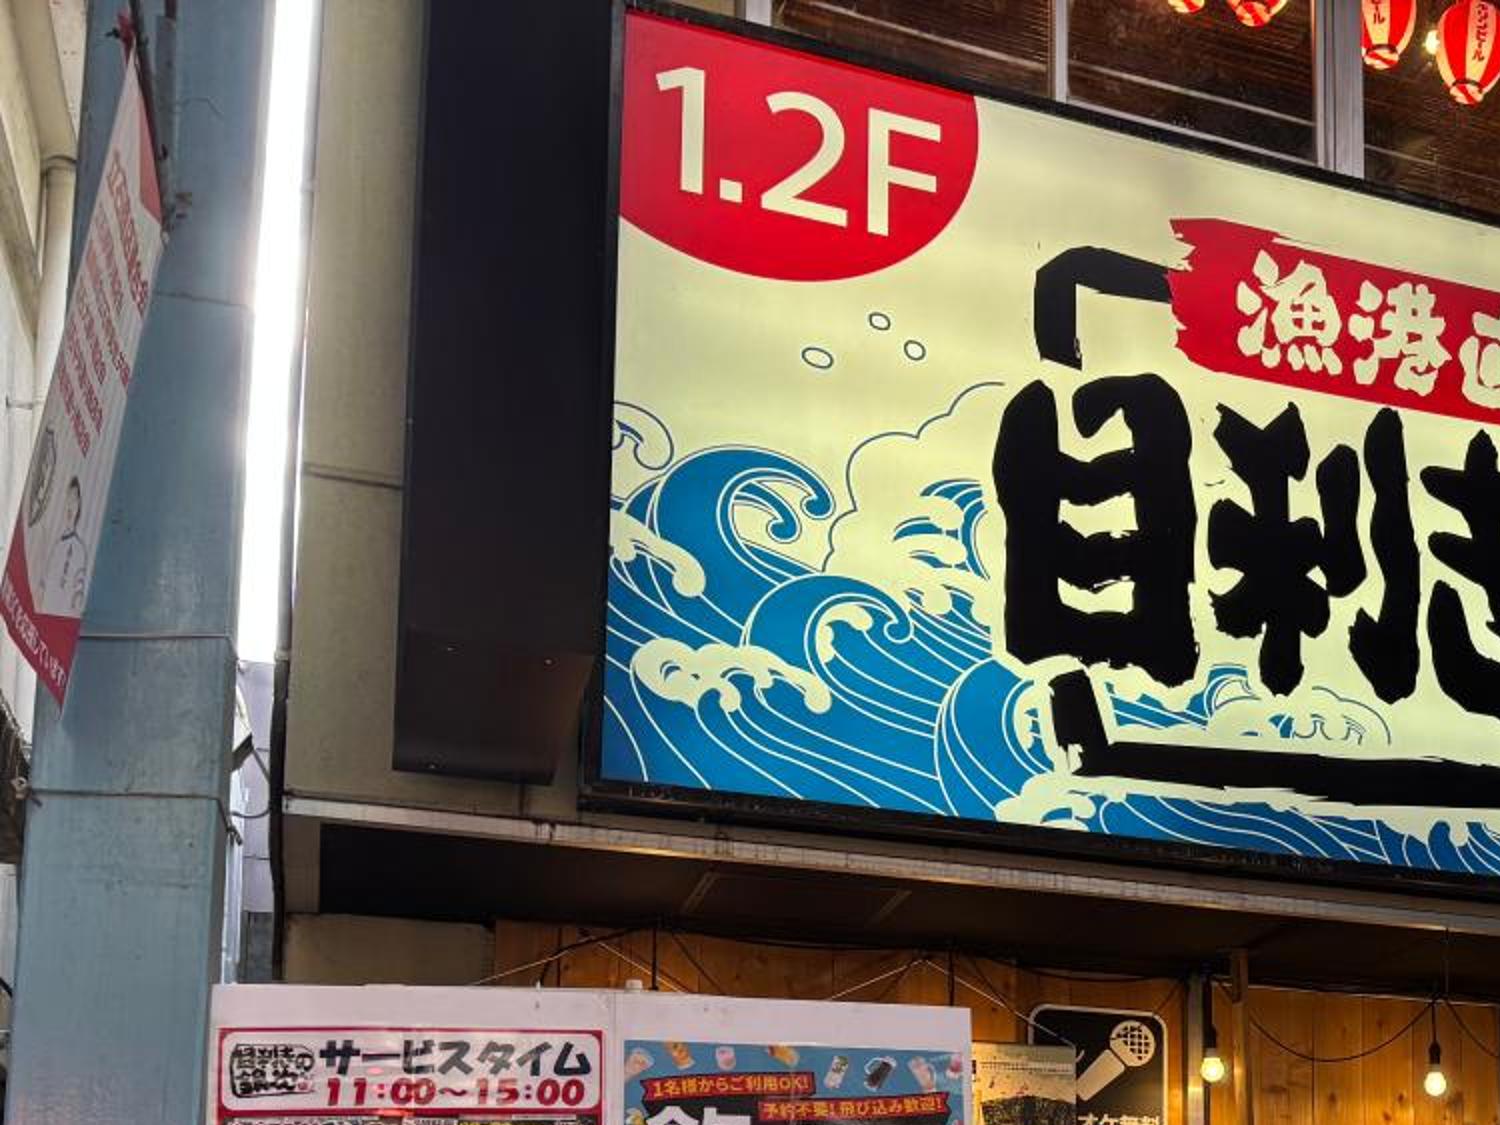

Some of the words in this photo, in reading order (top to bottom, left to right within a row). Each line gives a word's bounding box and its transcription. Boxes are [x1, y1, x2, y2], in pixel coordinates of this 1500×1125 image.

[655, 66, 942, 237] 1.2F
[319, 1039, 592, 1077] サービスタイム
